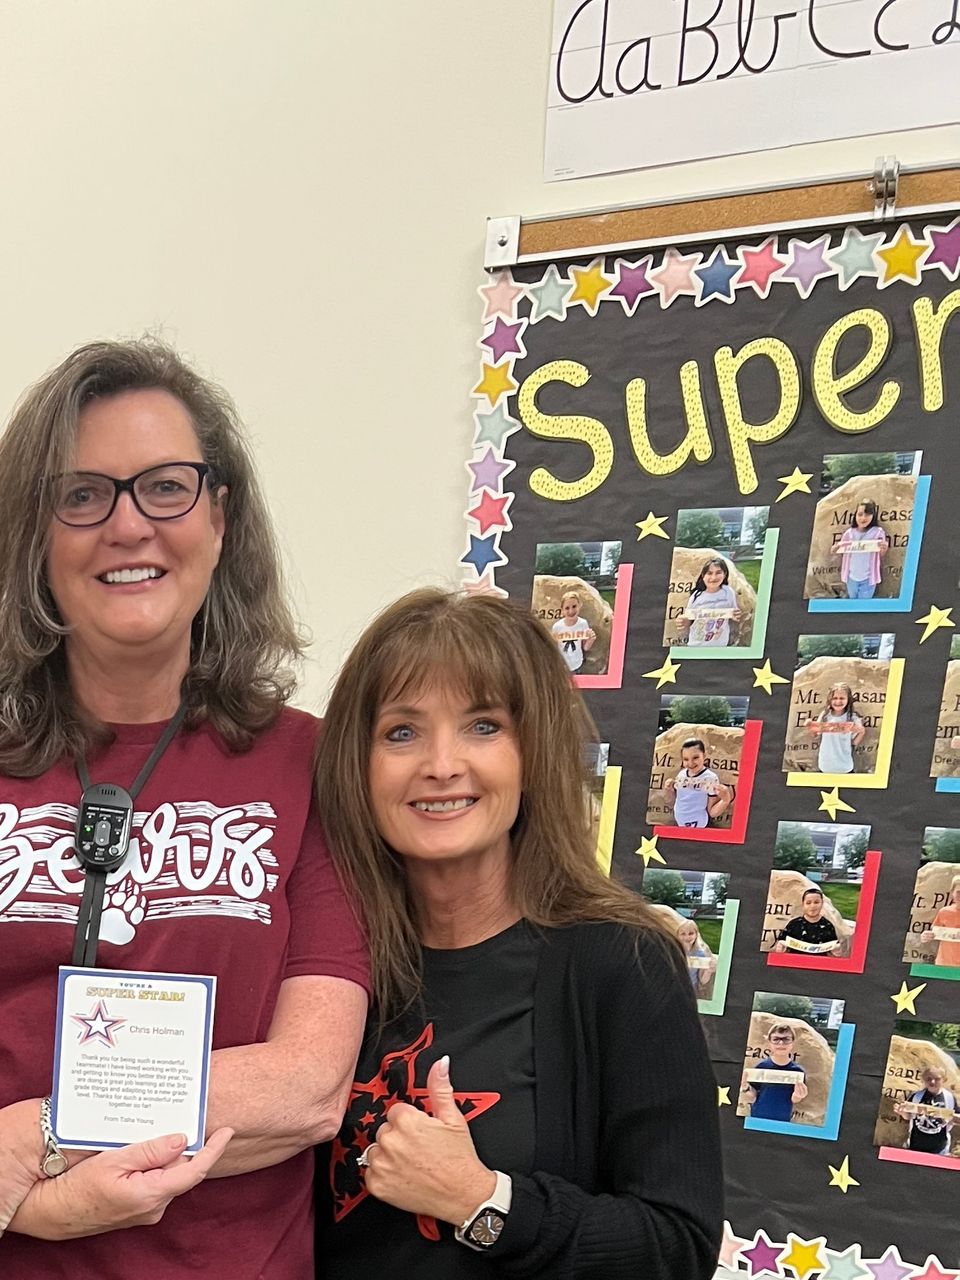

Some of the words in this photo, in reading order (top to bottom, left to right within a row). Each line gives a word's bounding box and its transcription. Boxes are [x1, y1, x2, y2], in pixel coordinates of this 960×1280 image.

[794, 690, 822, 704] Mt.
[86, 986, 136, 999] SUPER
[138, 990, 186, 1002] STAR!
[129, 1025, 150, 1034] Chris
[152, 1027, 185, 1036] Holman
[120, 1056, 136, 1064] being
[87, 1077, 103, 1085] doing
[135, 1080, 157, 1088] learning
[91, 1084, 108, 1092] things
[121, 1086, 146, 1095] adapting
[172, 1089, 188, 1097] grade
[137, 1117, 154, 1125] Young
